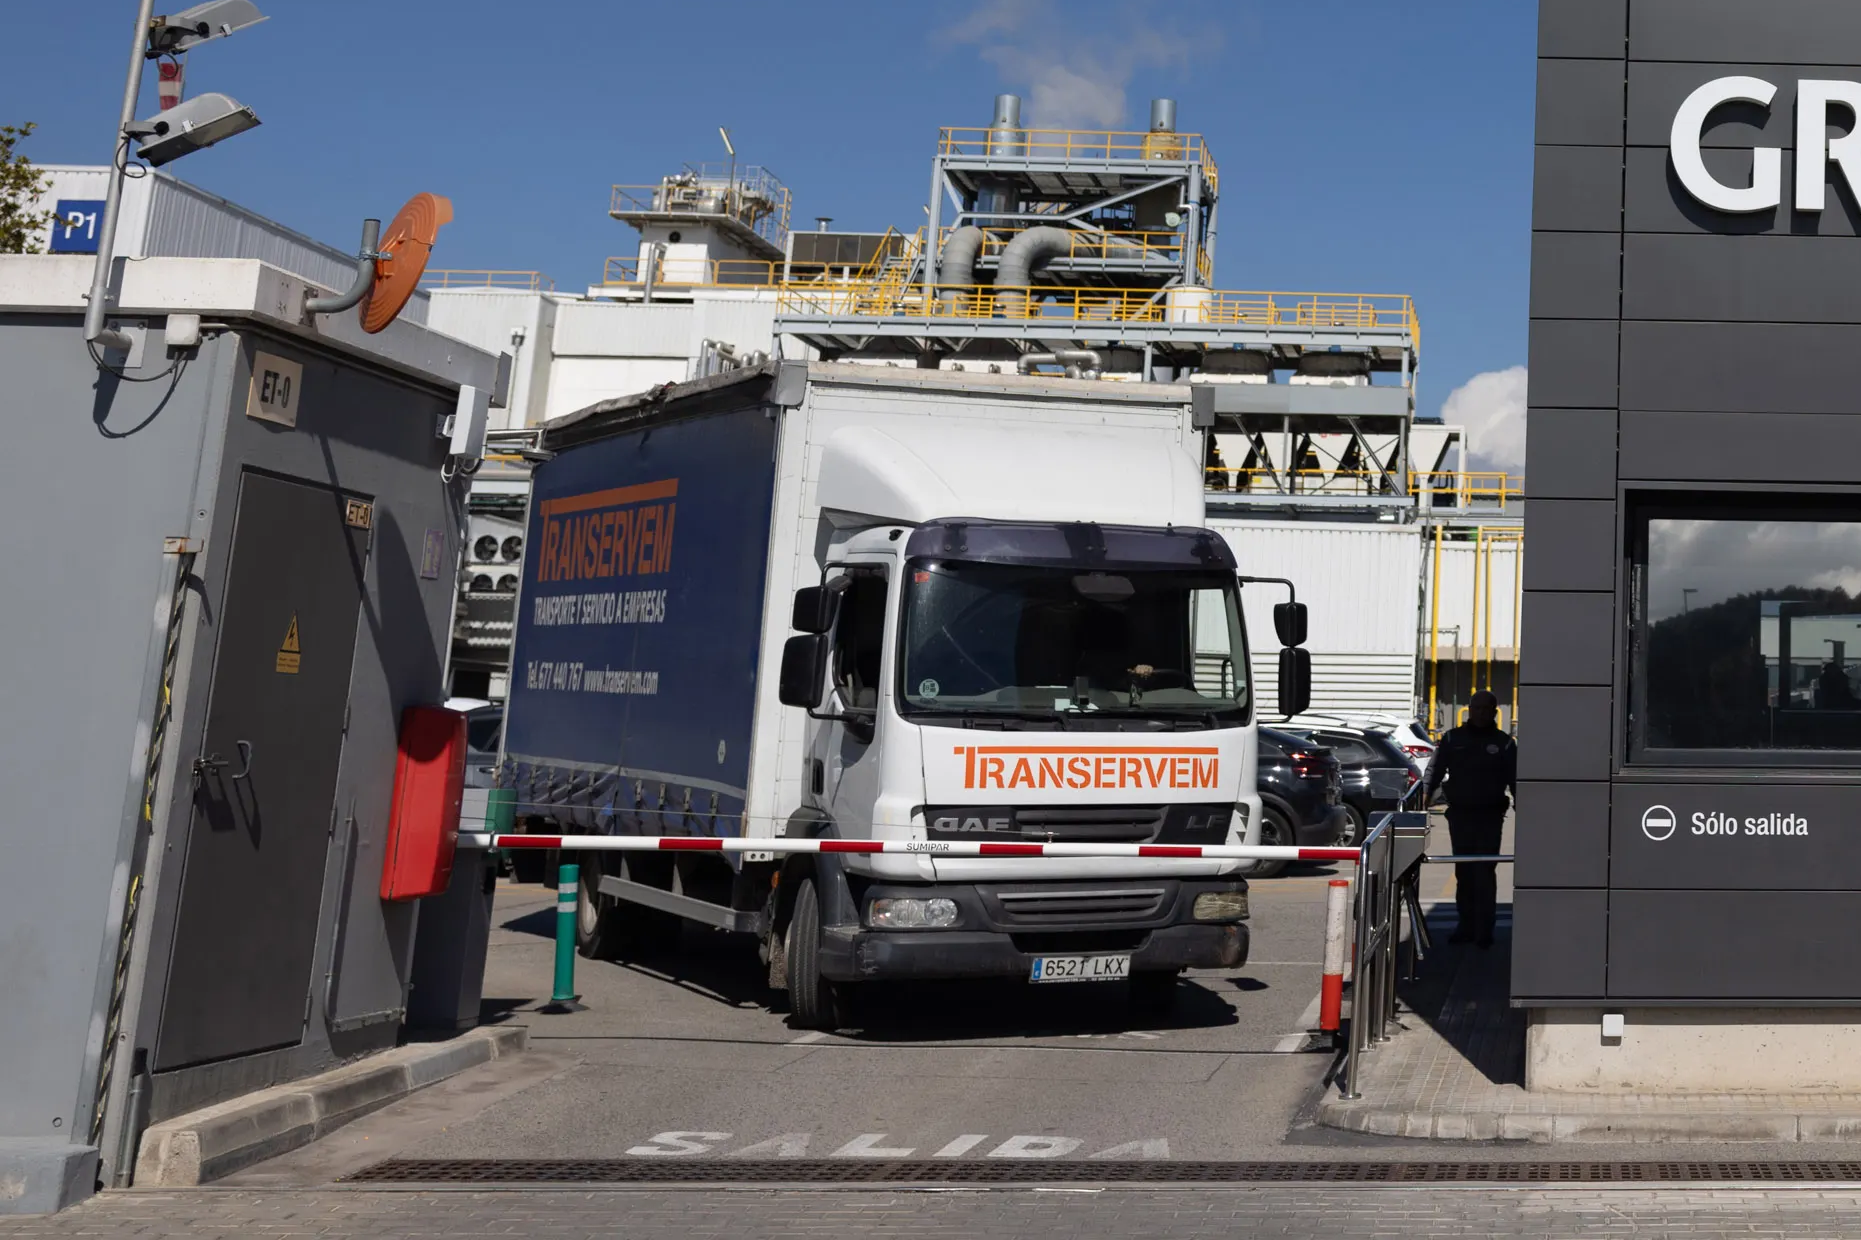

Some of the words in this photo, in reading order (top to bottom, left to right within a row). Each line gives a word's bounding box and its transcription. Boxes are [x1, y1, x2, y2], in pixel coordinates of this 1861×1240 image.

[64, 211, 97, 240] P1
[537, 478, 680, 583] TRANSERVEM
[534, 595, 577, 626] TRANSPORTE
[575, 594, 583, 625] Y
[581, 592, 617, 625] SERVICIO
[615, 592, 623, 624] A
[622, 589, 667, 624] EMPRESAS
[953, 746, 1219, 789] TRANSERVEM
[933, 817, 1011, 833] DAF
[1184, 815, 1228, 832] LF
[1691, 811, 1738, 835] Sólo
[1744, 812, 1809, 836] salida
[906, 842, 950, 853] SUMIPAR
[1045, 959, 1086, 977] 6521
[1093, 957, 1125, 975] LKX
[624, 1131, 1171, 1159] SALIDA
